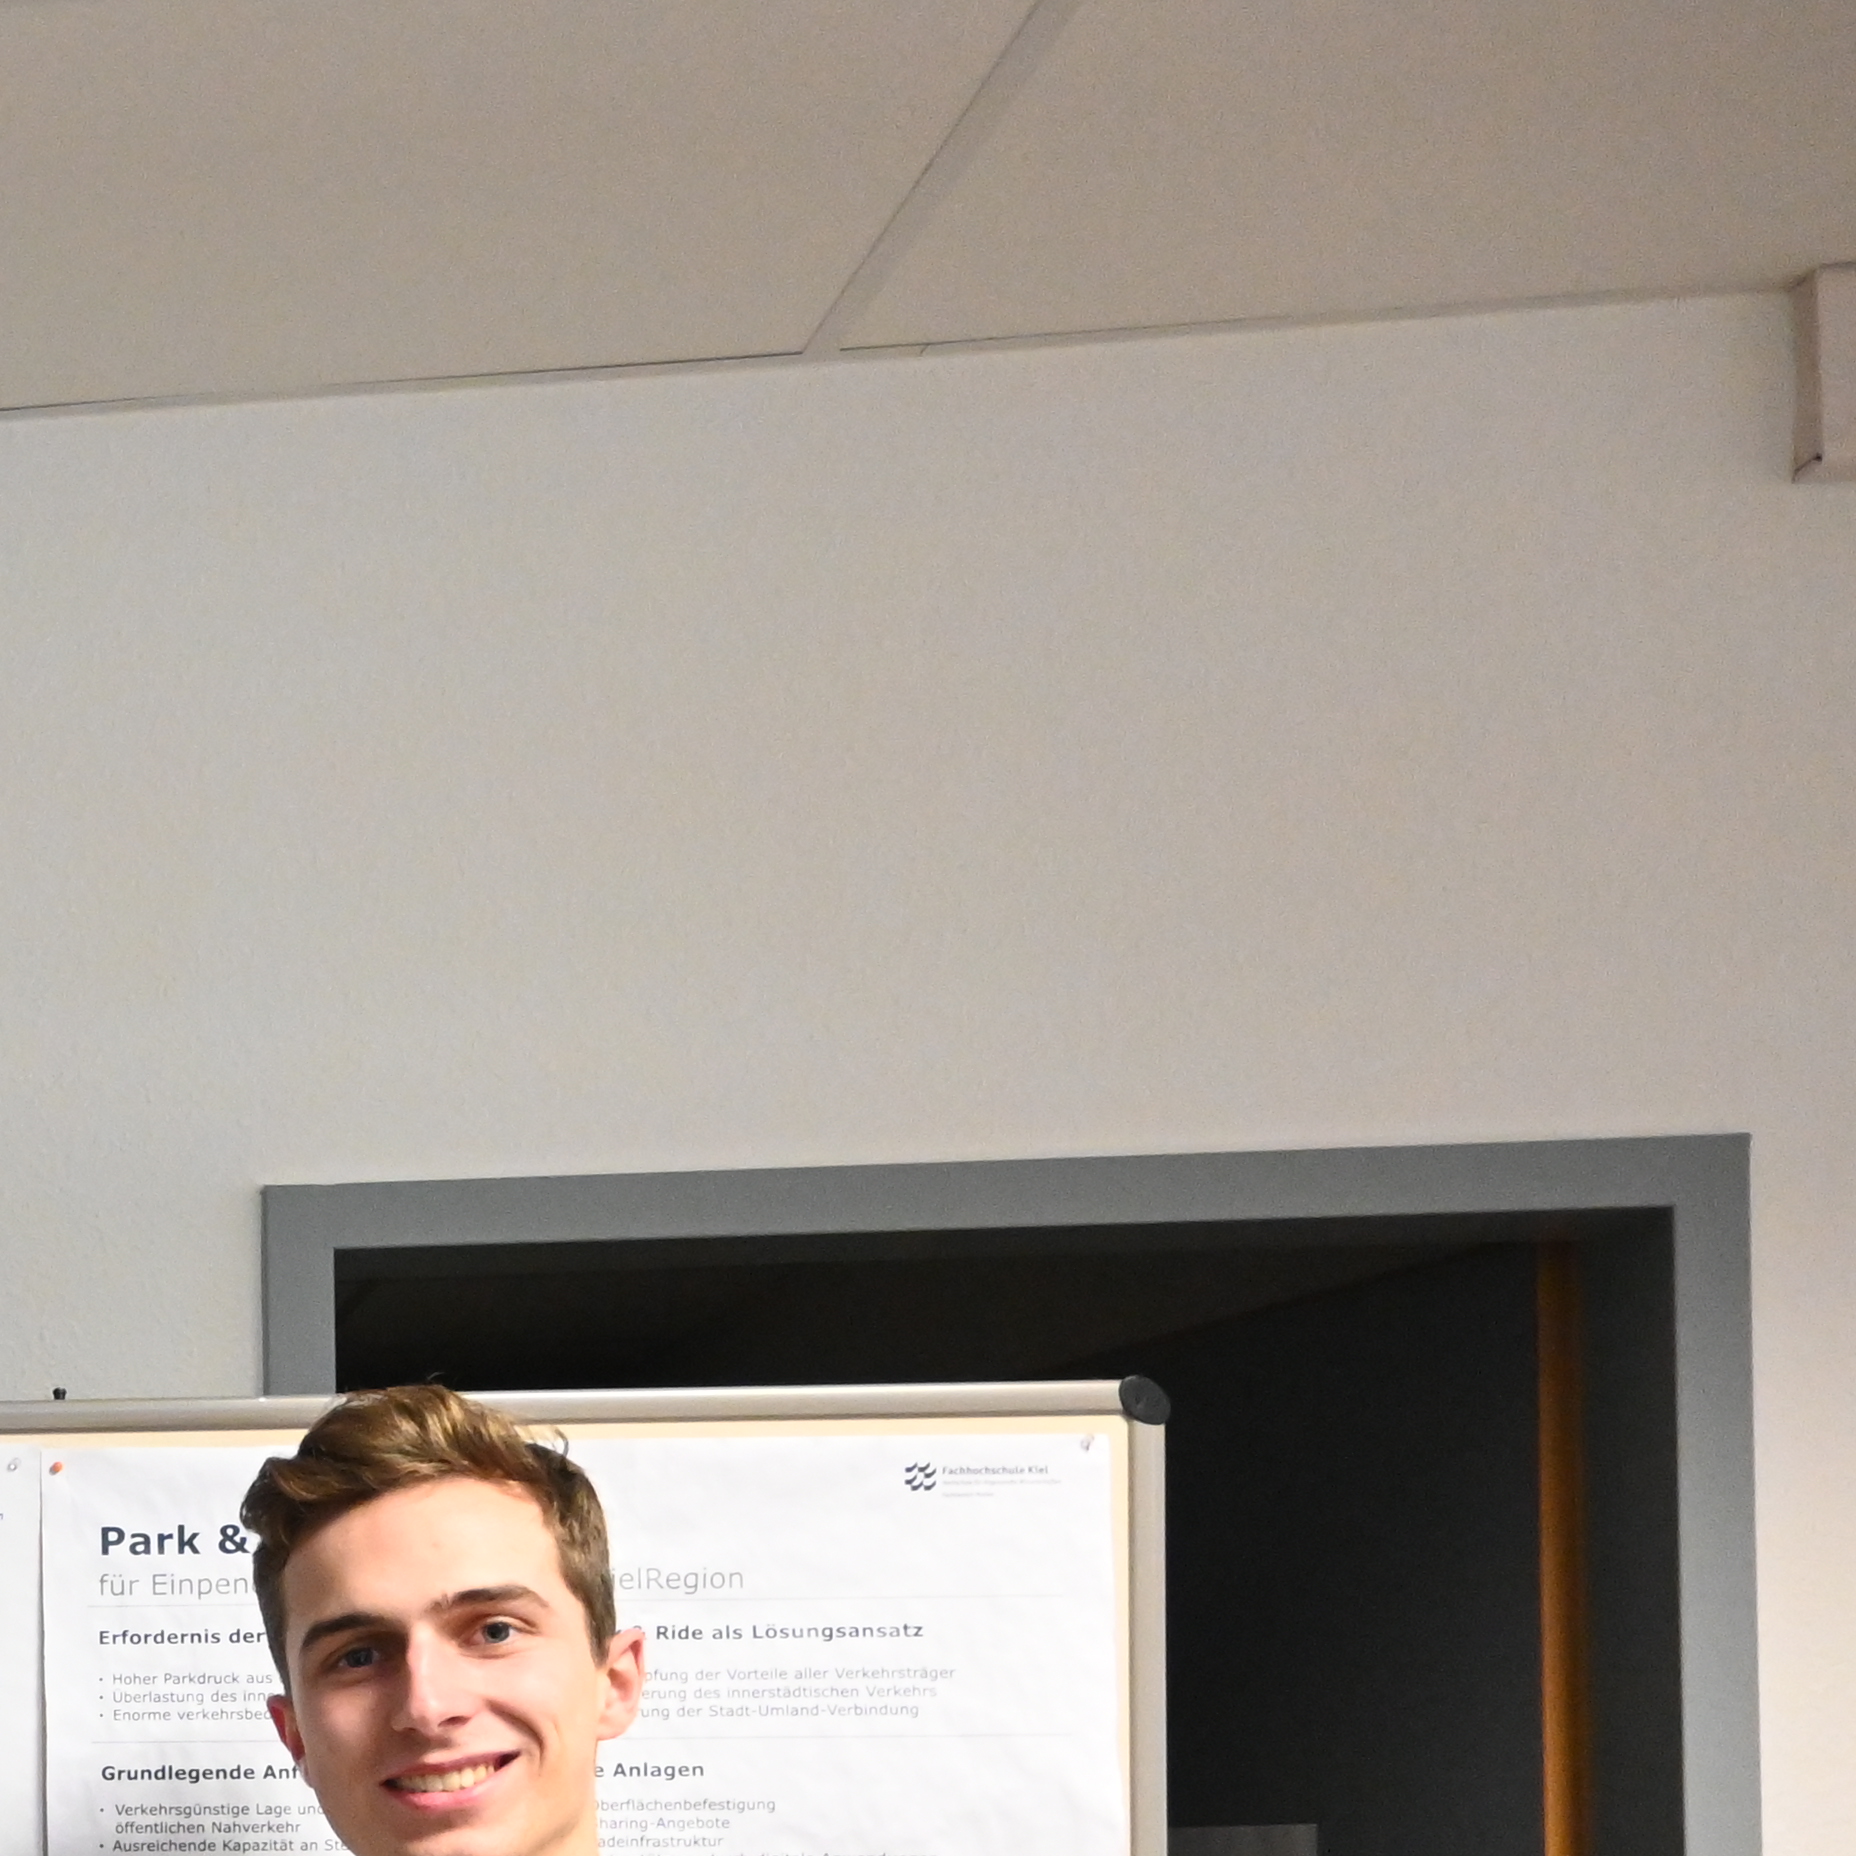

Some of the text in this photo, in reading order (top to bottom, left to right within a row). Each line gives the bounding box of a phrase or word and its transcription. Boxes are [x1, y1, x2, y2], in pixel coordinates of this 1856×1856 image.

[941, 1465, 1048, 1475] Fachhochschule Kiel
[100, 1524, 250, 1556] Park &
[98, 1572, 256, 1600] für Einpen
[99, 1628, 268, 1645] Erfordernis der
[656, 1624, 703, 1640] Ride
[711, 1624, 743, 1640] als
[752, 1623, 923, 1642] Lösungsansatz
[112, 1671, 272, 1685] Hoher Parkdruck aus
[694, 1668, 721, 1681] der
[726, 1667, 788, 1681] Vorteile
[793, 1666, 829, 1680] aller
[834, 1666, 956, 1682] Verkehrsträger
[112, 1689, 274, 1706] Überlastung des inn
[693, 1687, 720, 1699] des
[726, 1685, 859, 1699] innerstädtischen
[865, 1684, 937, 1698] Verkehrs
[112, 1708, 171, 1721] Enorme
[676, 1705, 703, 1718] der
[708, 1702, 919, 1719] Stadt-Umland-Verbindung
[101, 1764, 255, 1784] Grundlegende
[612, 1761, 704, 1781] Anlagen
[114, 1803, 250, 1819] Verkehrsgünstige
[256, 1803, 291, 1818] Lage
[114, 1820, 300, 1834] öffentlichen Nahverkehr
[112, 1838, 216, 1852] Ausreichende
[222, 1839, 294, 1854] Kapazität
[299, 1841, 318, 1851] an
